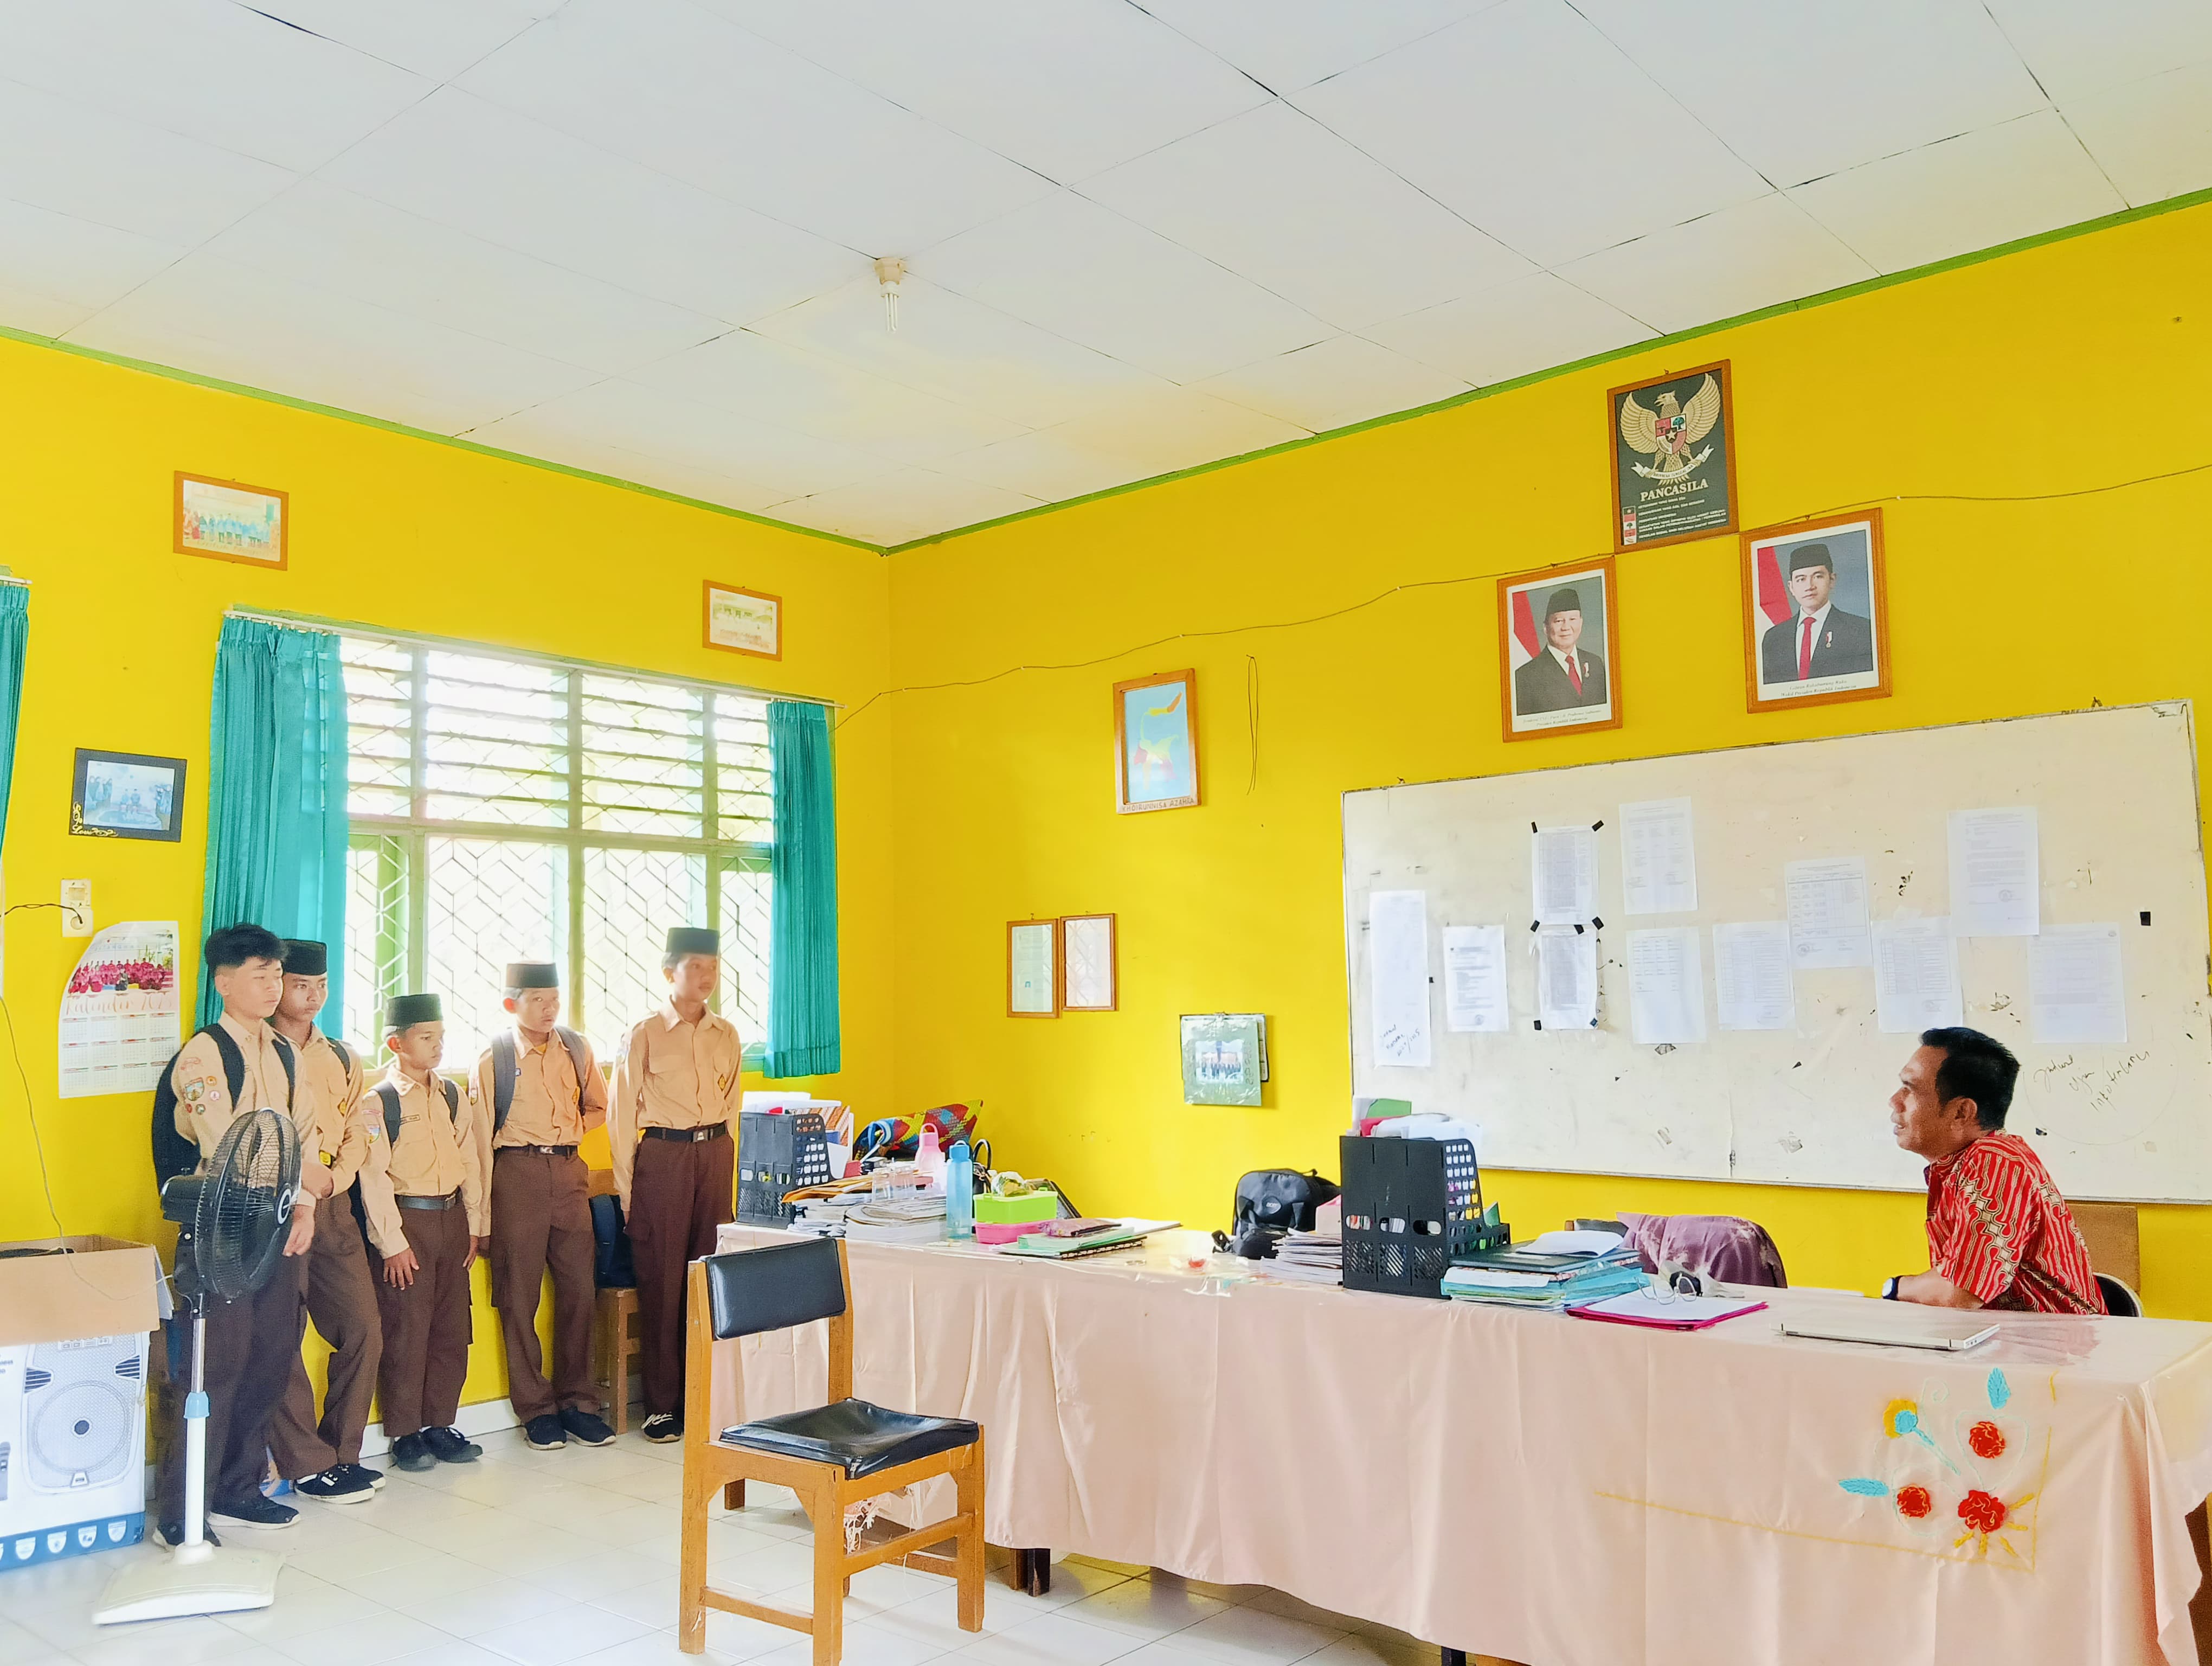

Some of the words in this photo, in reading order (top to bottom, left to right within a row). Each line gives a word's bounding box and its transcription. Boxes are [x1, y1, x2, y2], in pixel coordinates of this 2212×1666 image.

[1640, 478, 1708, 502] PANCASILA
[1122, 802, 1167, 812] KHOIRUNNISA
[1169, 798, 1194, 808] AZAHRA
